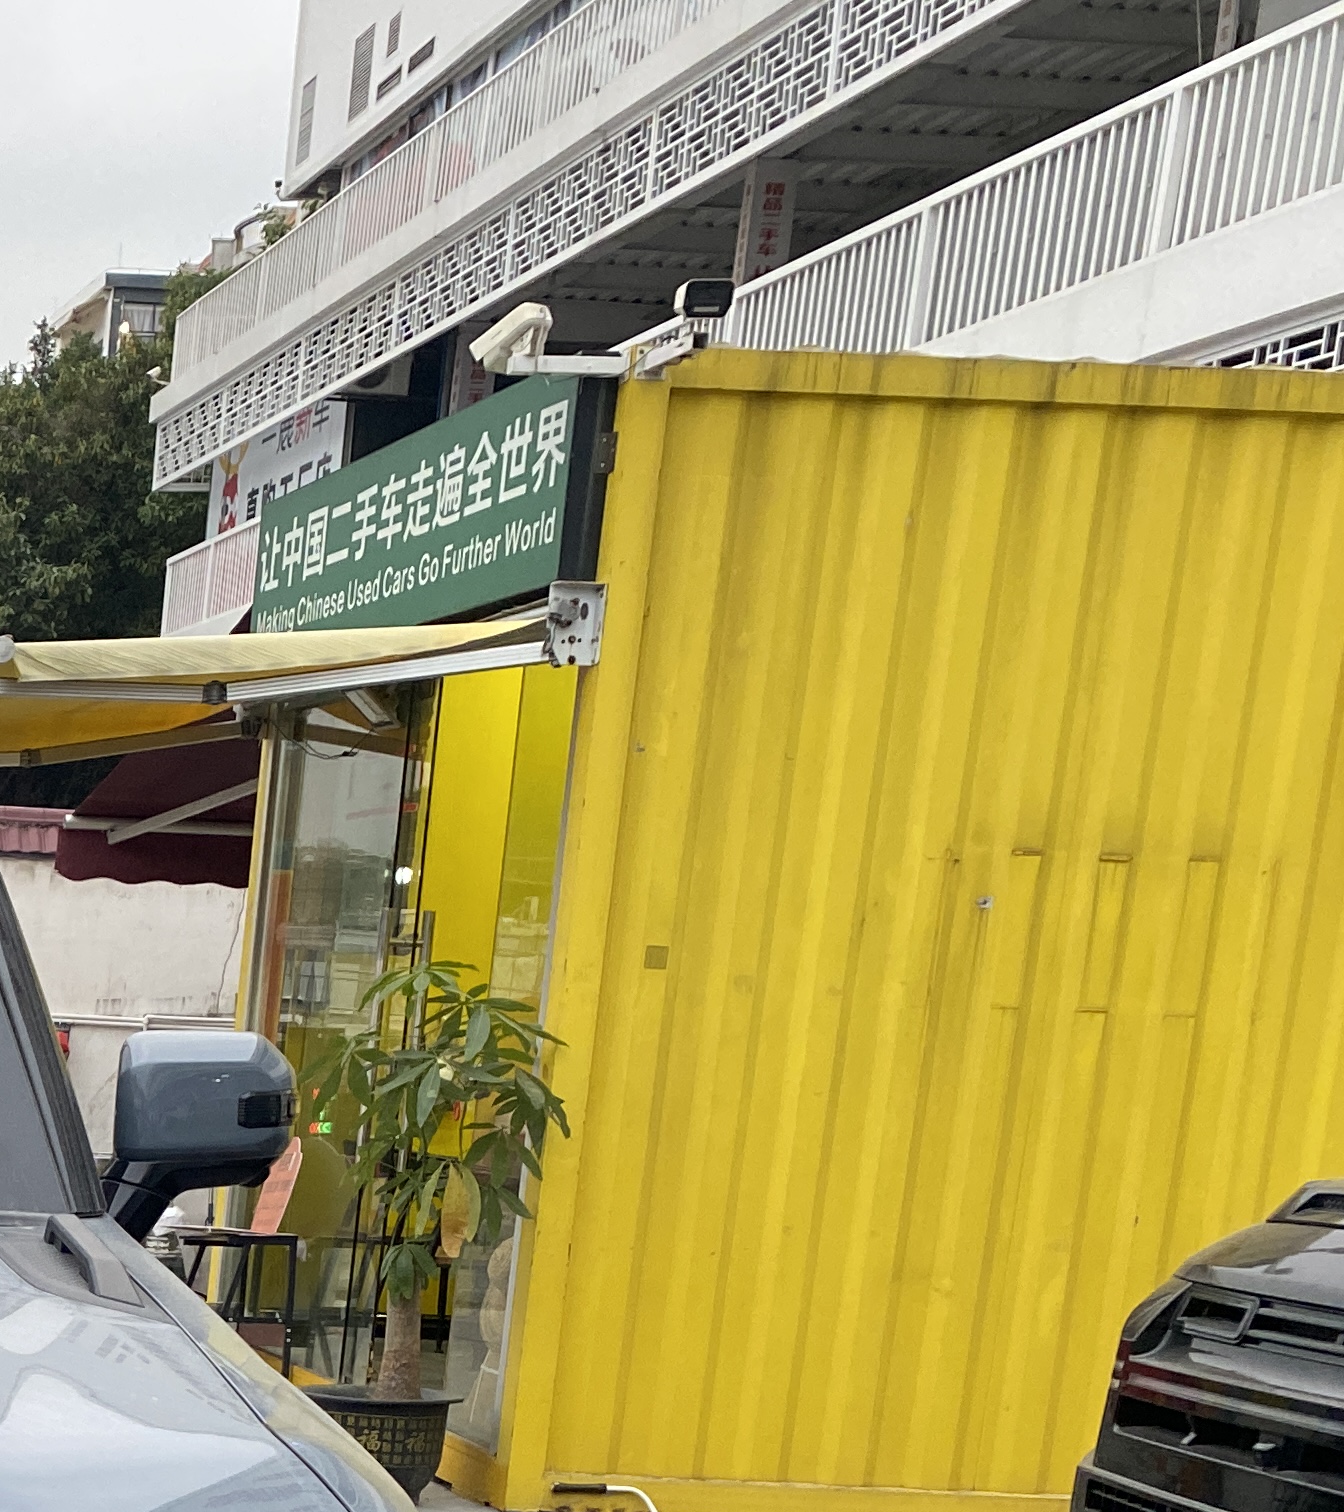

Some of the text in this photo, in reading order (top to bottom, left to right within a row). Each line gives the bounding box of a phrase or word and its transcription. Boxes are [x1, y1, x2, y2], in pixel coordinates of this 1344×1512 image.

[257, 507, 557, 633] Making Chinese Used Cars Go Further World
[260, 399, 569, 593] 让中国二手车走遍全世界
